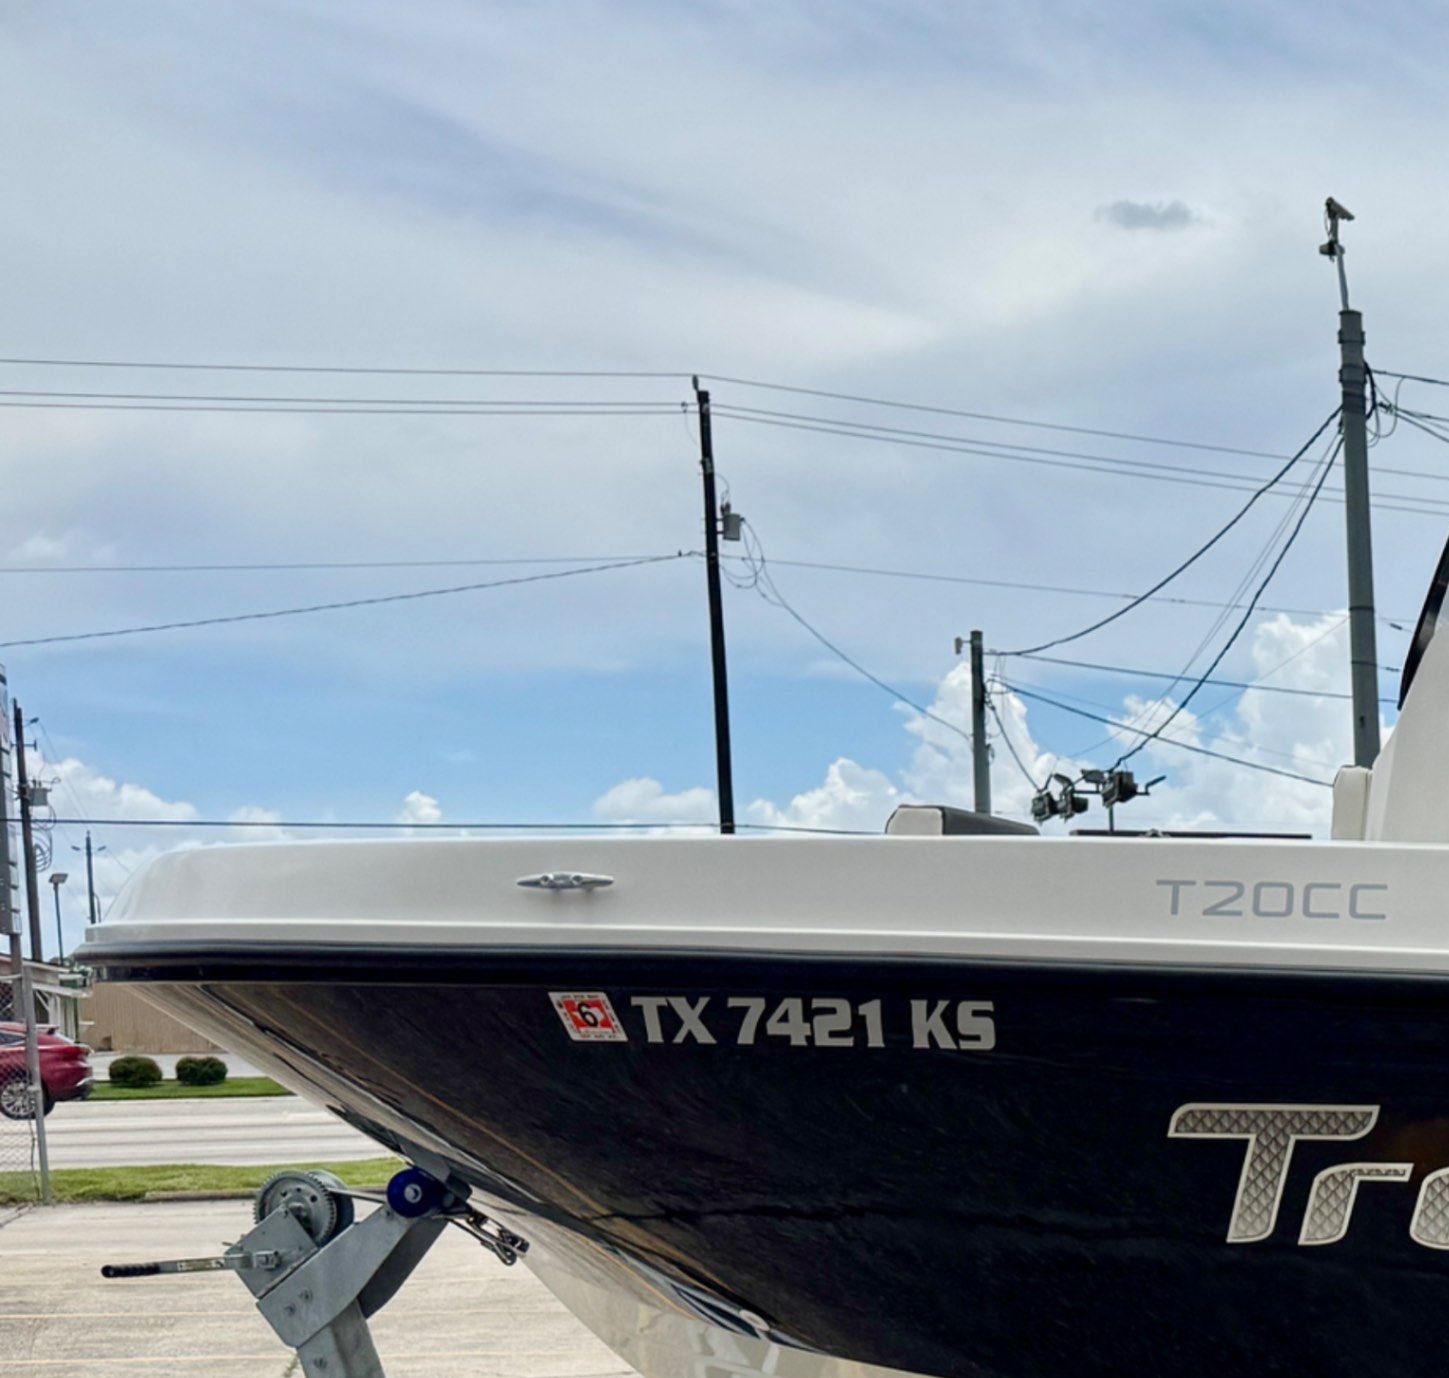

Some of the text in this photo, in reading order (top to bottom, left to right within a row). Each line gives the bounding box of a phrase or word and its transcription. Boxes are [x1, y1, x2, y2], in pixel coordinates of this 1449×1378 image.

[1156, 879, 1388, 920] T20CC
[577, 1002, 599, 1028] 6
[630, 996, 718, 1044] TX
[726, 997, 886, 1048] 7421
[910, 999, 997, 1050] KS
